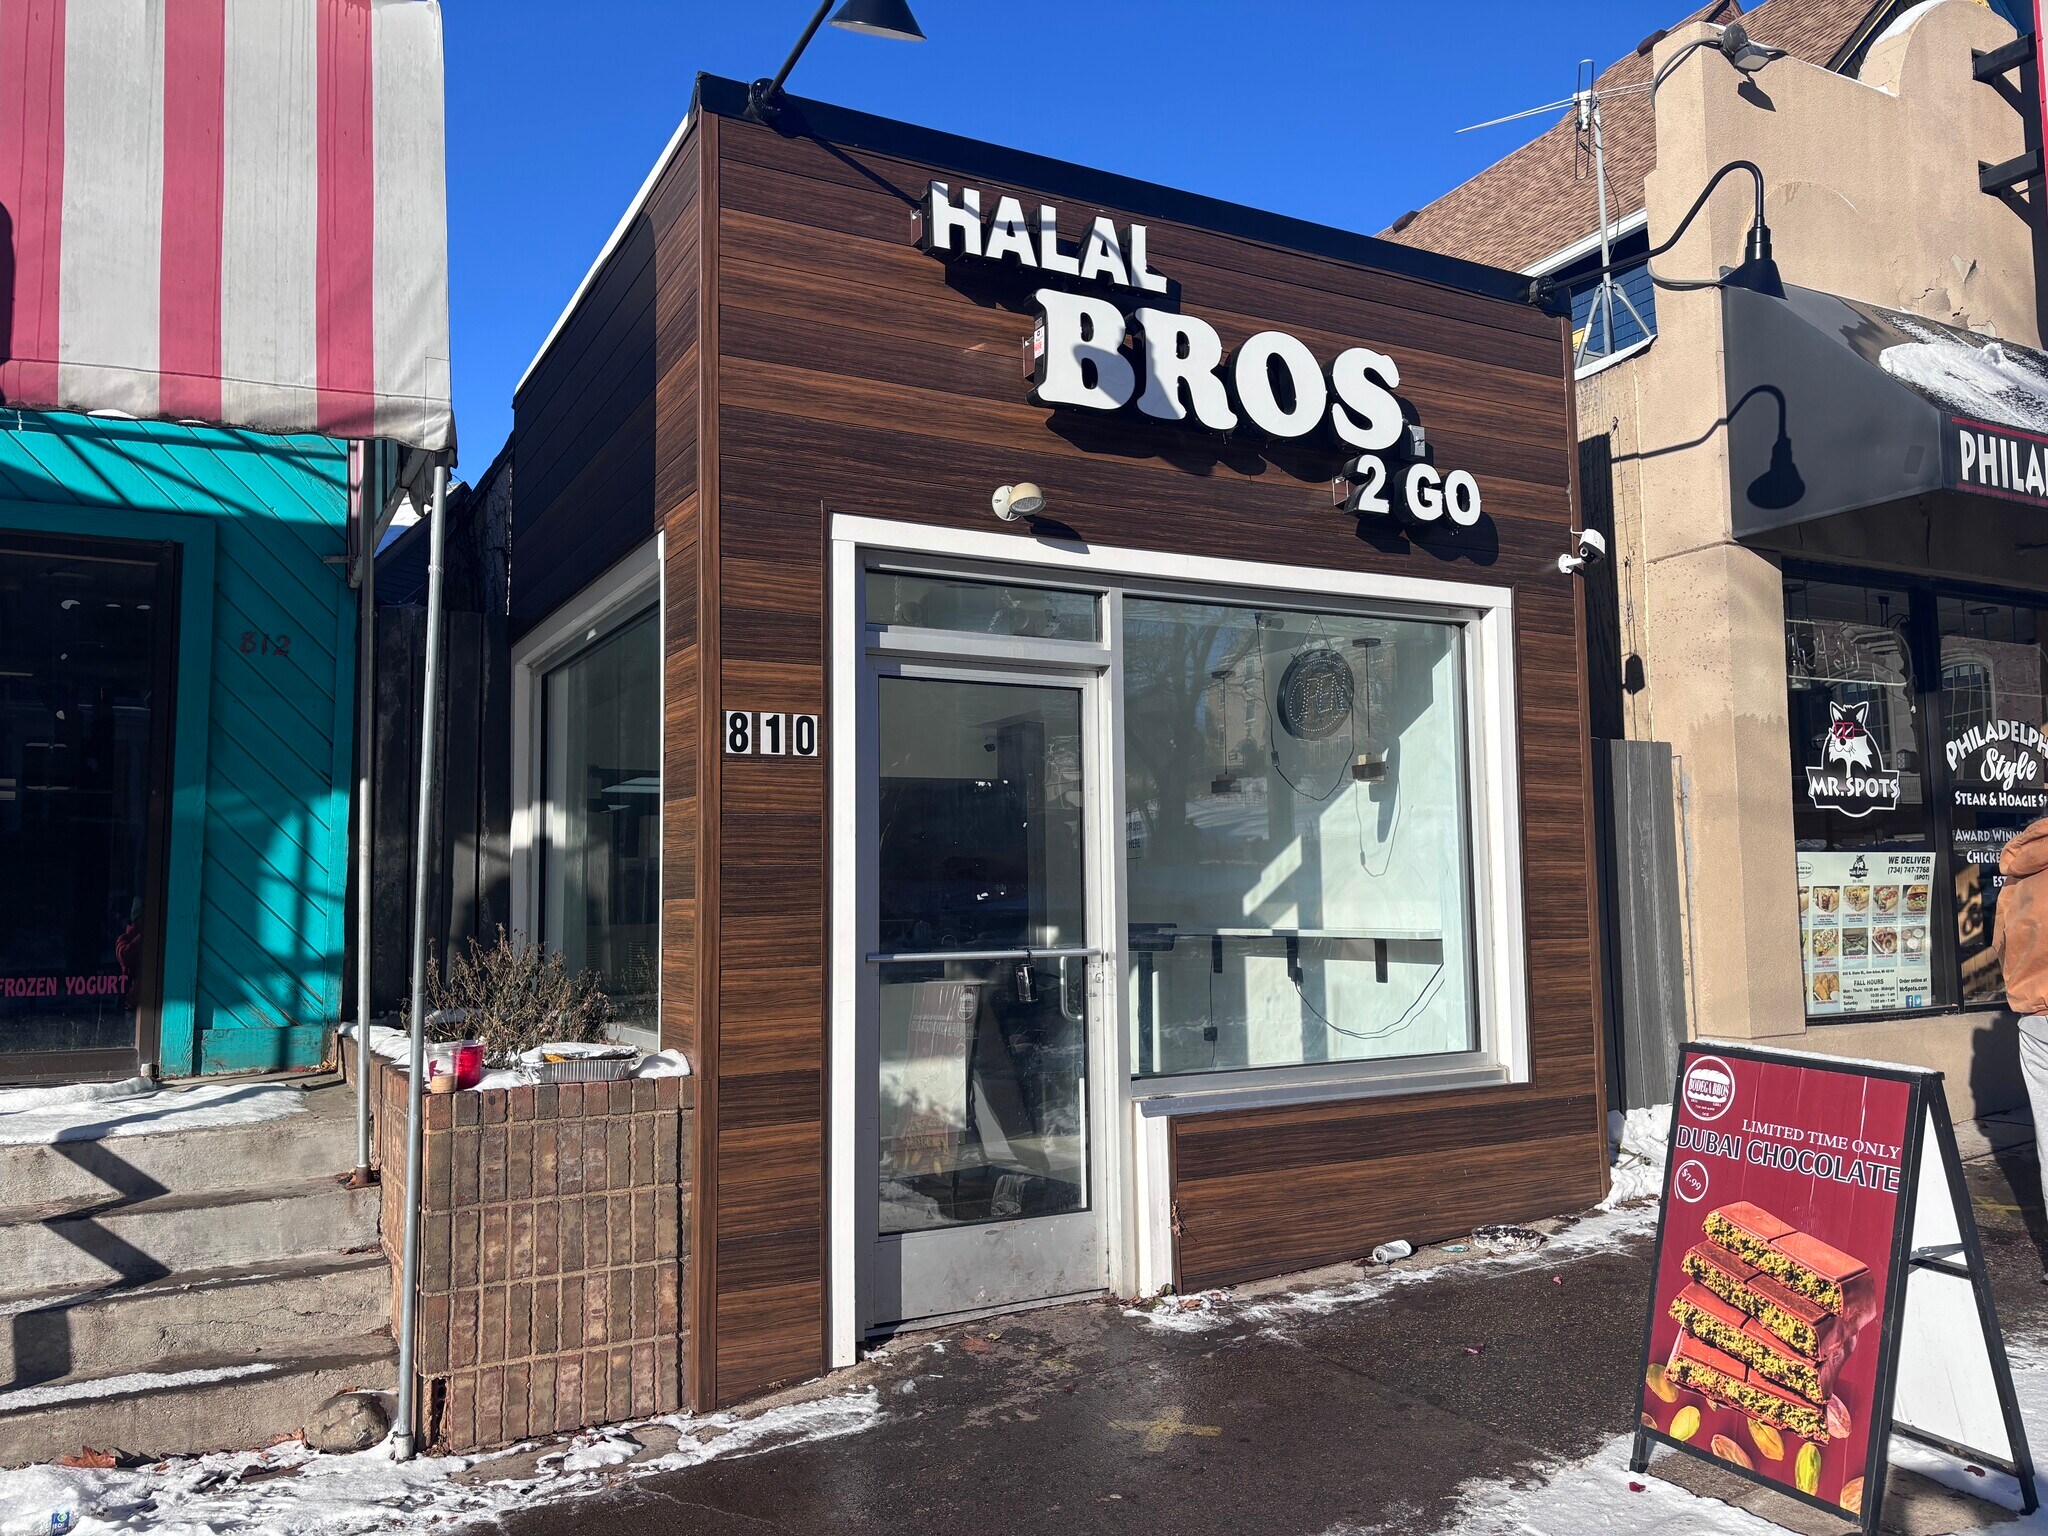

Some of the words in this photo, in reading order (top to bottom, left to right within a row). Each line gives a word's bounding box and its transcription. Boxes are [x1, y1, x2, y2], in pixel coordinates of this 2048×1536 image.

[930, 180, 1168, 294] HALAL
[1035, 288, 1404, 450] BROS
[1959, 429, 2048, 498] PHILA
[1355, 454, 1390, 515] 2
[1405, 462, 1481, 527] GO
[239, 631, 292, 657] 812
[728, 711, 816, 756] 810
[1945, 719, 2048, 772] PHILADELPH
[1980, 747, 2039, 792] Style
[1809, 776, 1845, 797] MR.
[1845, 777, 1899, 798] SPOTS
[1954, 790, 1987, 806] STEAK
[1989, 791, 1998, 806] &
[1998, 792, 2038, 808] HOAGIE
[1955, 828, 1991, 842] AWARD
[1887, 866, 1903, 875] (734)
[1888, 856, 1900, 864] WE
[1900, 856, 1931, 864] DELIVER
[64, 974, 129, 996] YOGURT
[1866, 978, 1885, 986] HOURS
[1711, 1082, 1730, 1098] BROS
[1741, 1119, 1805, 1142] LIMITED
[1807, 1130, 1849, 1150] TIME
[1851, 1139, 1902, 1160] ONLY
[1675, 1124, 1742, 1161] DUBAI
[1745, 1139, 1902, 1195] CHOCOLATE
[1681, 1167, 1702, 1192] $7.99
